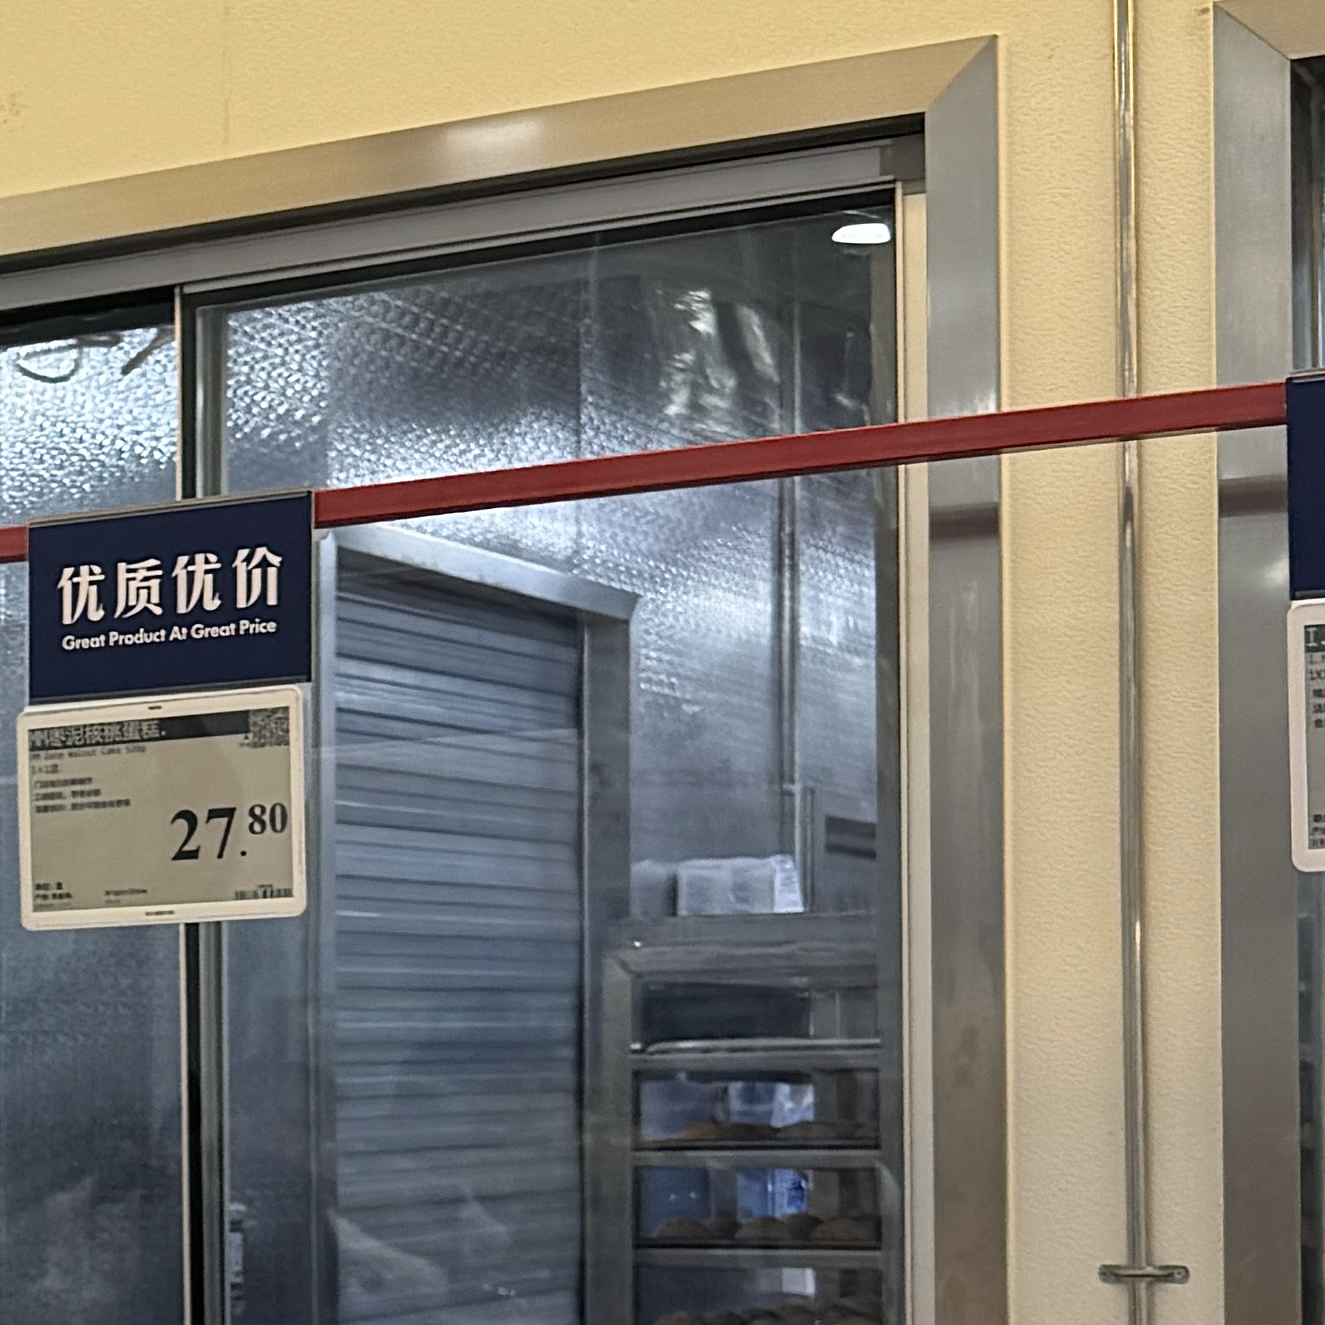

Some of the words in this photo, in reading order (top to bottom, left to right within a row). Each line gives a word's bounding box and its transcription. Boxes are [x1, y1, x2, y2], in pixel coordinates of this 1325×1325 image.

[57, 547, 282, 624] 优质优价
[62, 635, 105, 650] Great
[109, 628, 165, 645] Product
[170, 626, 186, 641] At
[191, 623, 235, 638] Great
[239, 618, 277, 634] Price
[170, 802, 288, 860] 27.80
